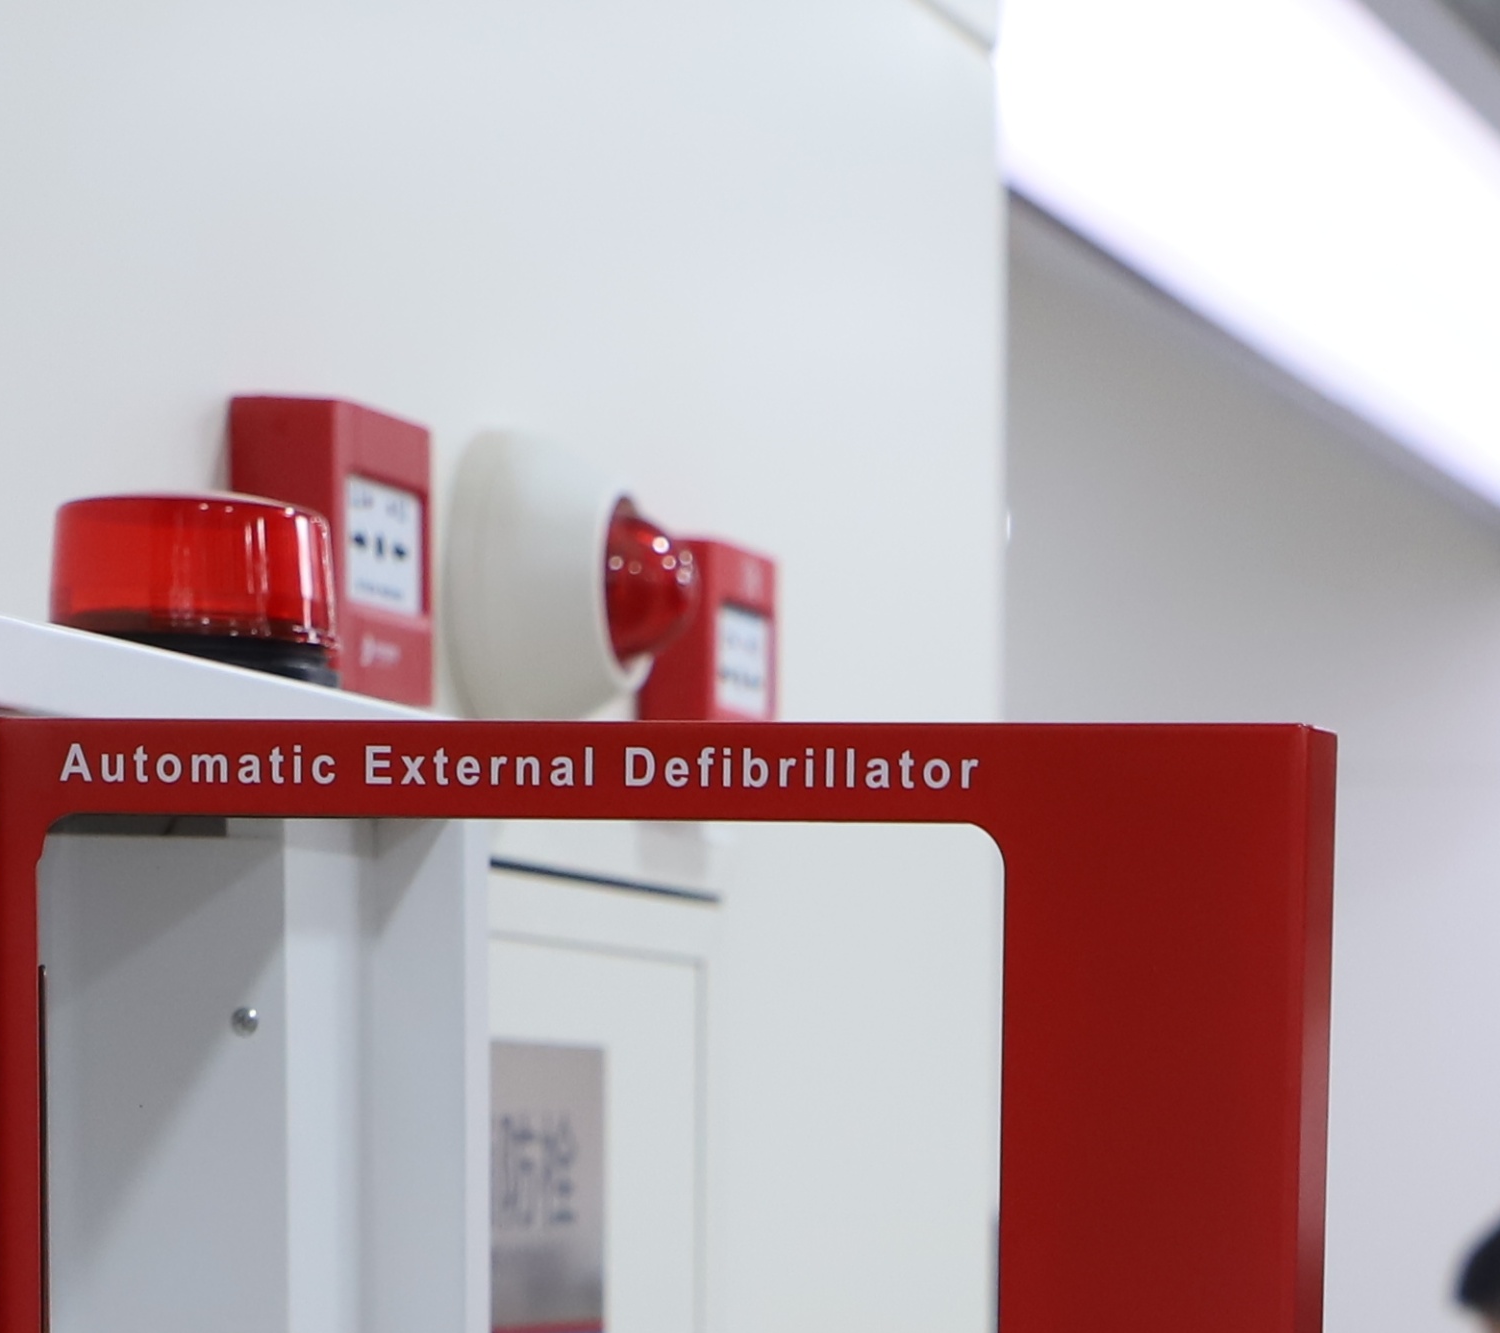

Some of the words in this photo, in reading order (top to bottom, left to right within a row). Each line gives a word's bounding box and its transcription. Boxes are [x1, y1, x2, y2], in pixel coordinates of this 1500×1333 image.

[60, 743, 335, 784] Automatic
[366, 746, 594, 786] External
[625, 747, 979, 789] Defibrillator
